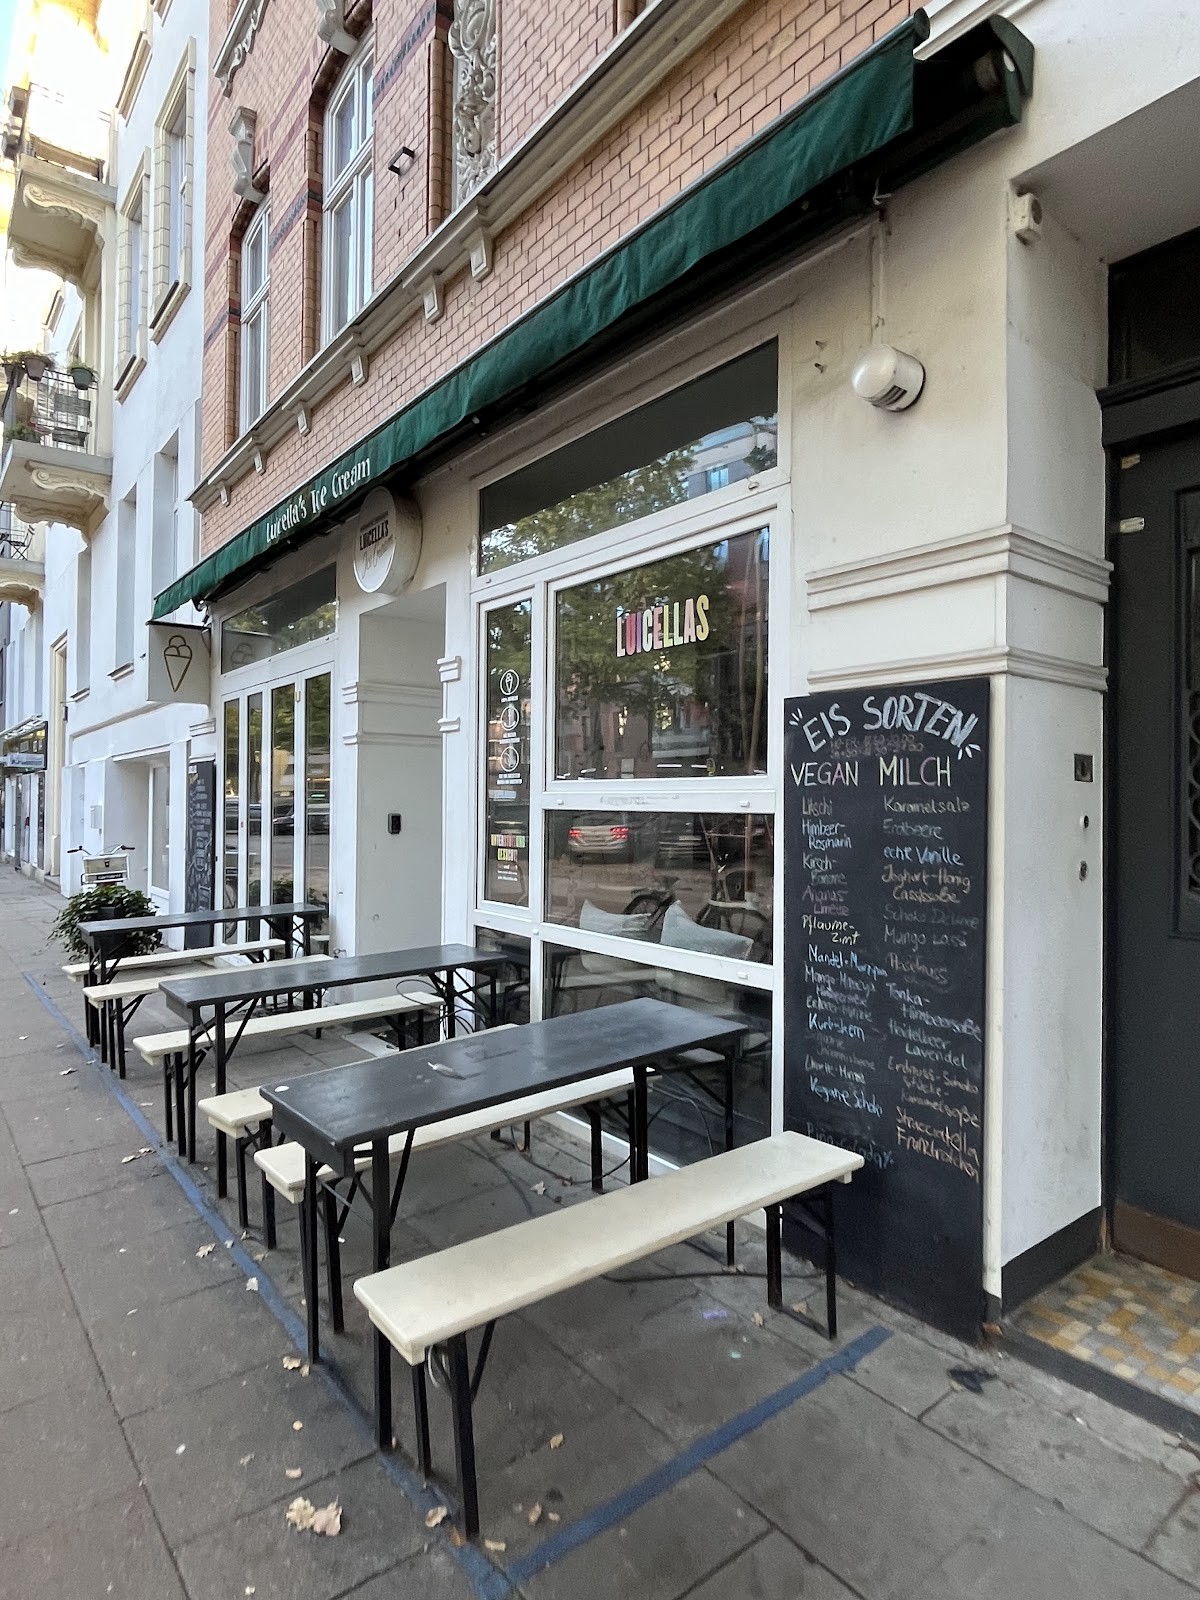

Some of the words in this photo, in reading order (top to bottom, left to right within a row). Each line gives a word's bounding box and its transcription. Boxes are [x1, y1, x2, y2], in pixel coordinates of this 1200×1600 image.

[266, 494, 307, 543] Lucella's
[310, 486, 327, 514] Ice
[332, 458, 370, 499] Cream
[616, 594, 710, 658] LUICELLAS
[803, 703, 851, 752] EIS
[862, 692, 979, 748] SORTEN
[790, 760, 860, 787] VEGAN
[879, 754, 951, 788] MILCH
[905, 1042, 968, 1071] Lavendel
